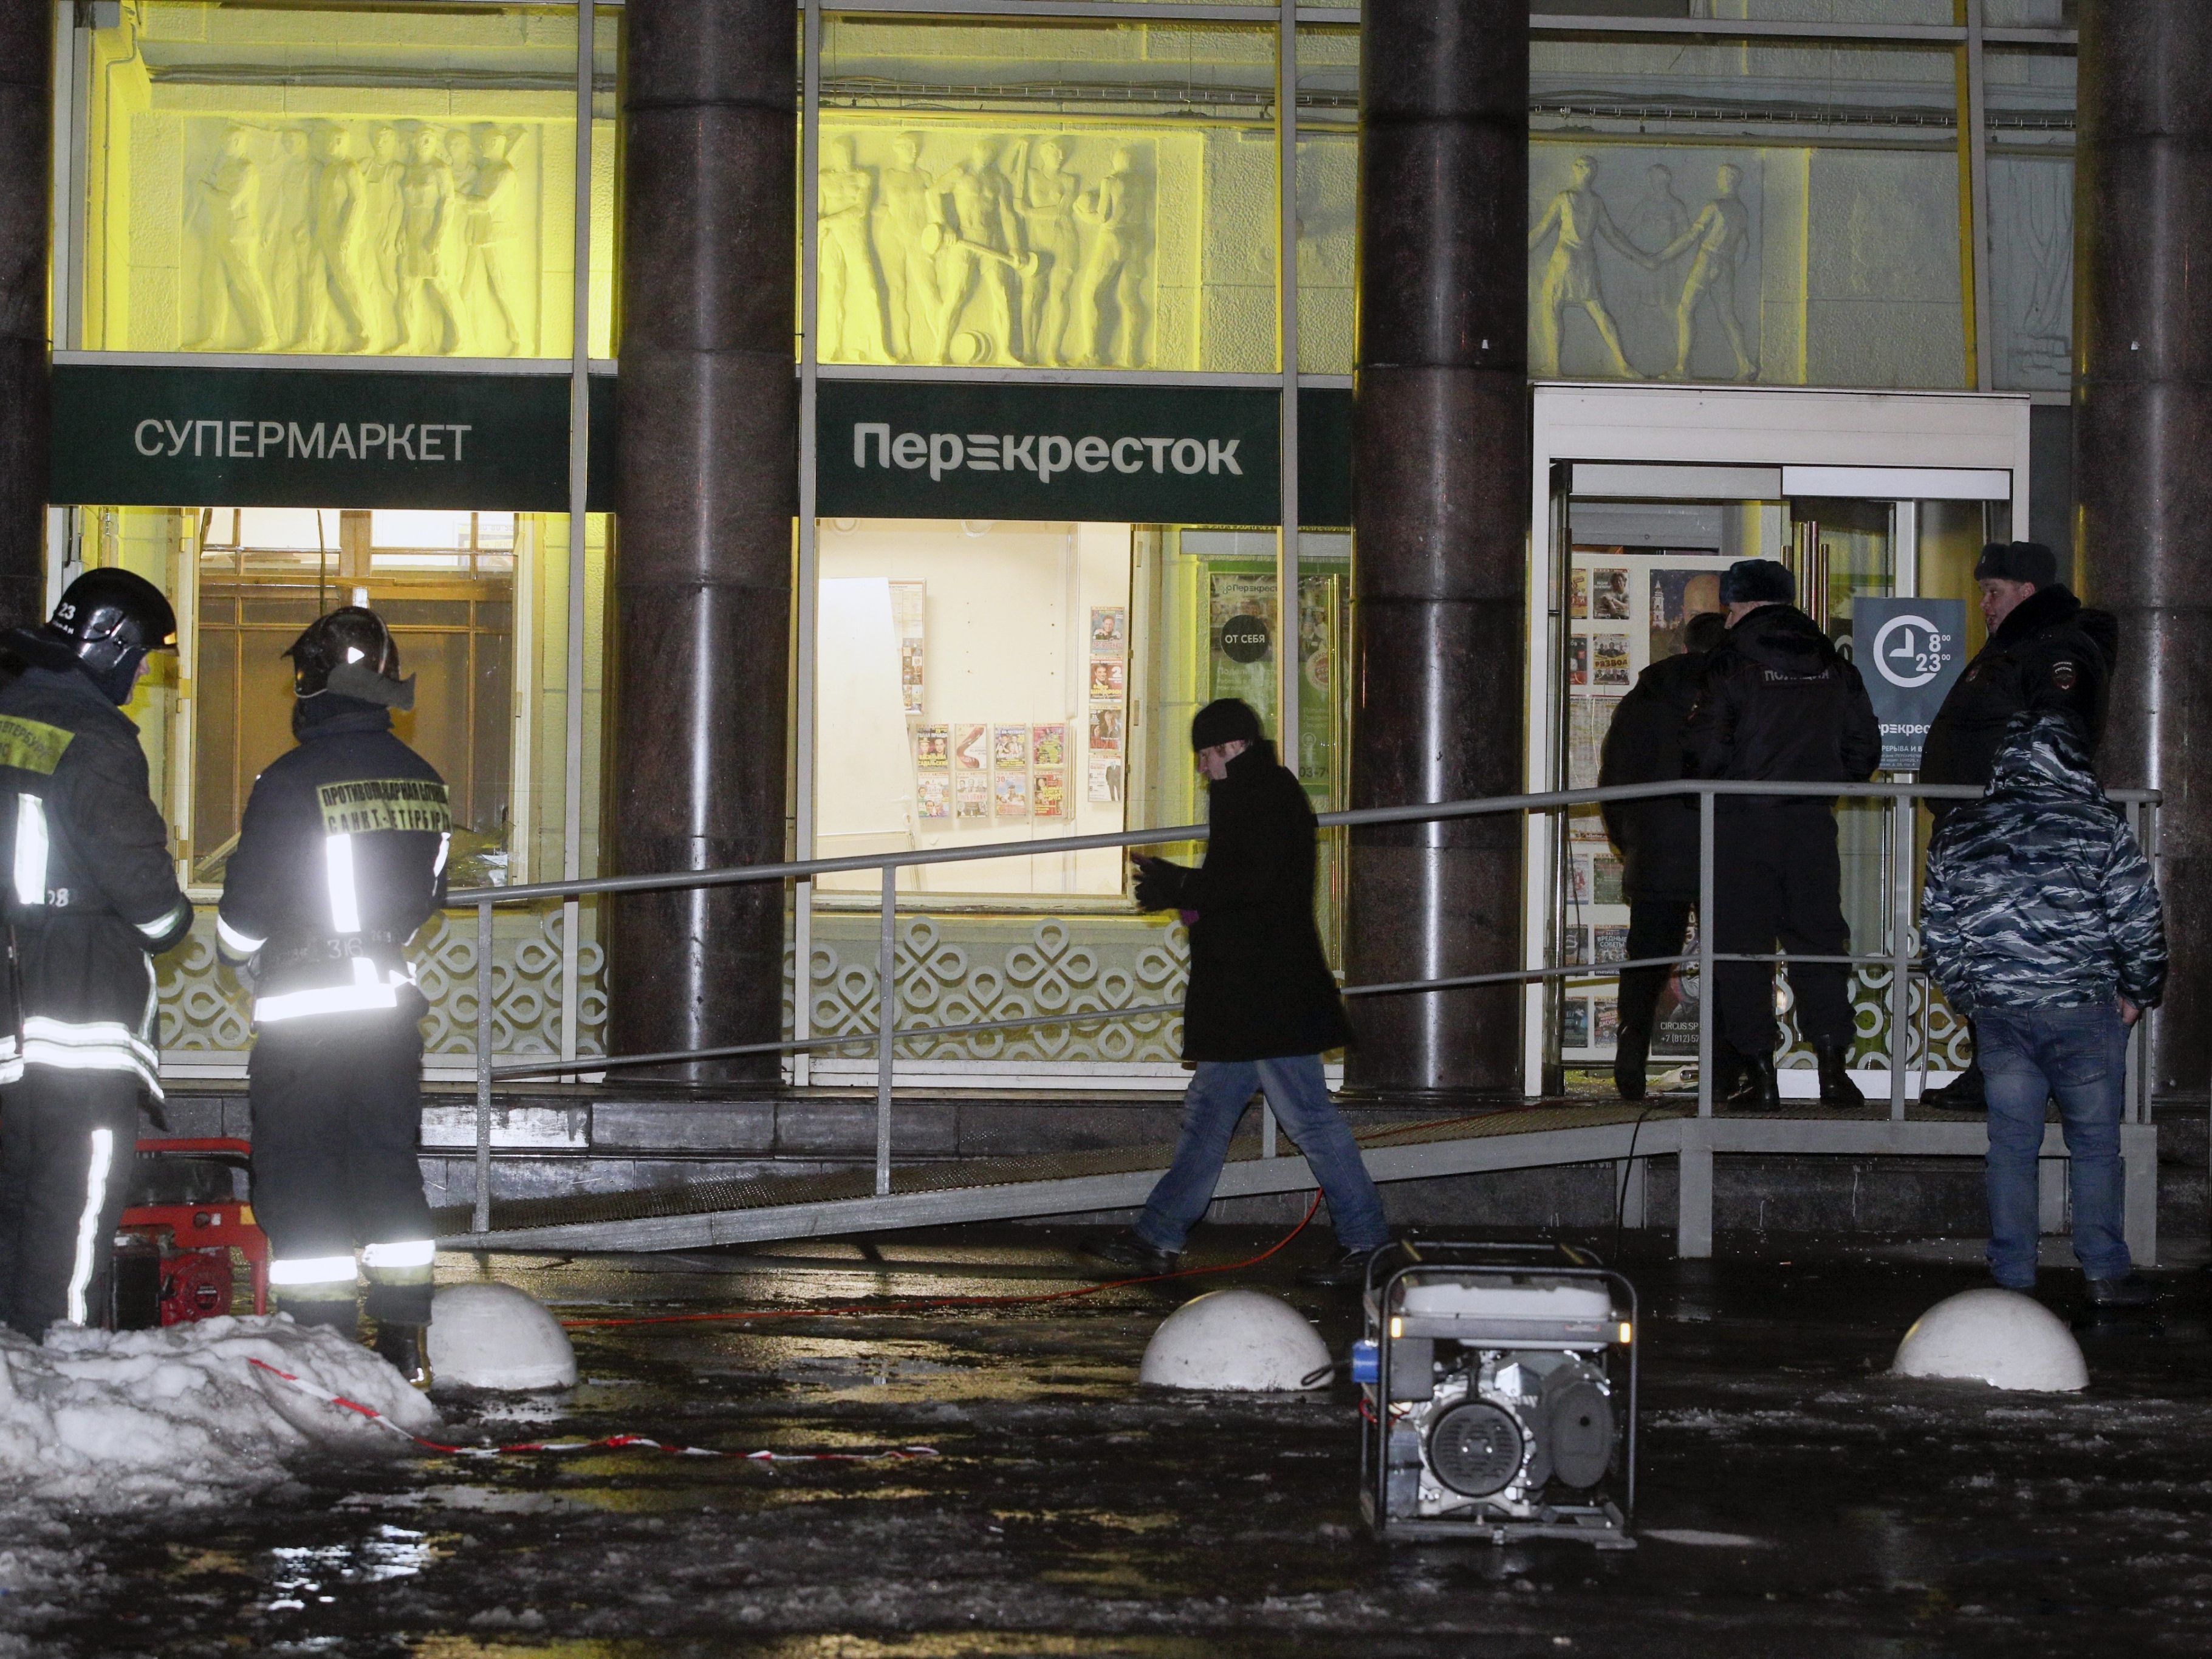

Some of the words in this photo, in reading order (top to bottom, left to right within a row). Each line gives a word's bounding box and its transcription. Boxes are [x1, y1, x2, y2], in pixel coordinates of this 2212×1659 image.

[134, 419, 472, 460] СУПЕРМАРКЕТ
[854, 422, 1243, 484] Перекресток
[58, 602, 76, 620] 23
[1225, 635, 1238, 643] ОТ
[1241, 634, 1265, 643] СЕБЯ
[1595, 658, 1628, 668] РАЗВОД
[1111, 666, 1122, 678] 2
[1878, 723, 1931, 736] рекрес
[327, 937, 365, 959] 316
[1672, 1035, 1690, 1043] (812)
